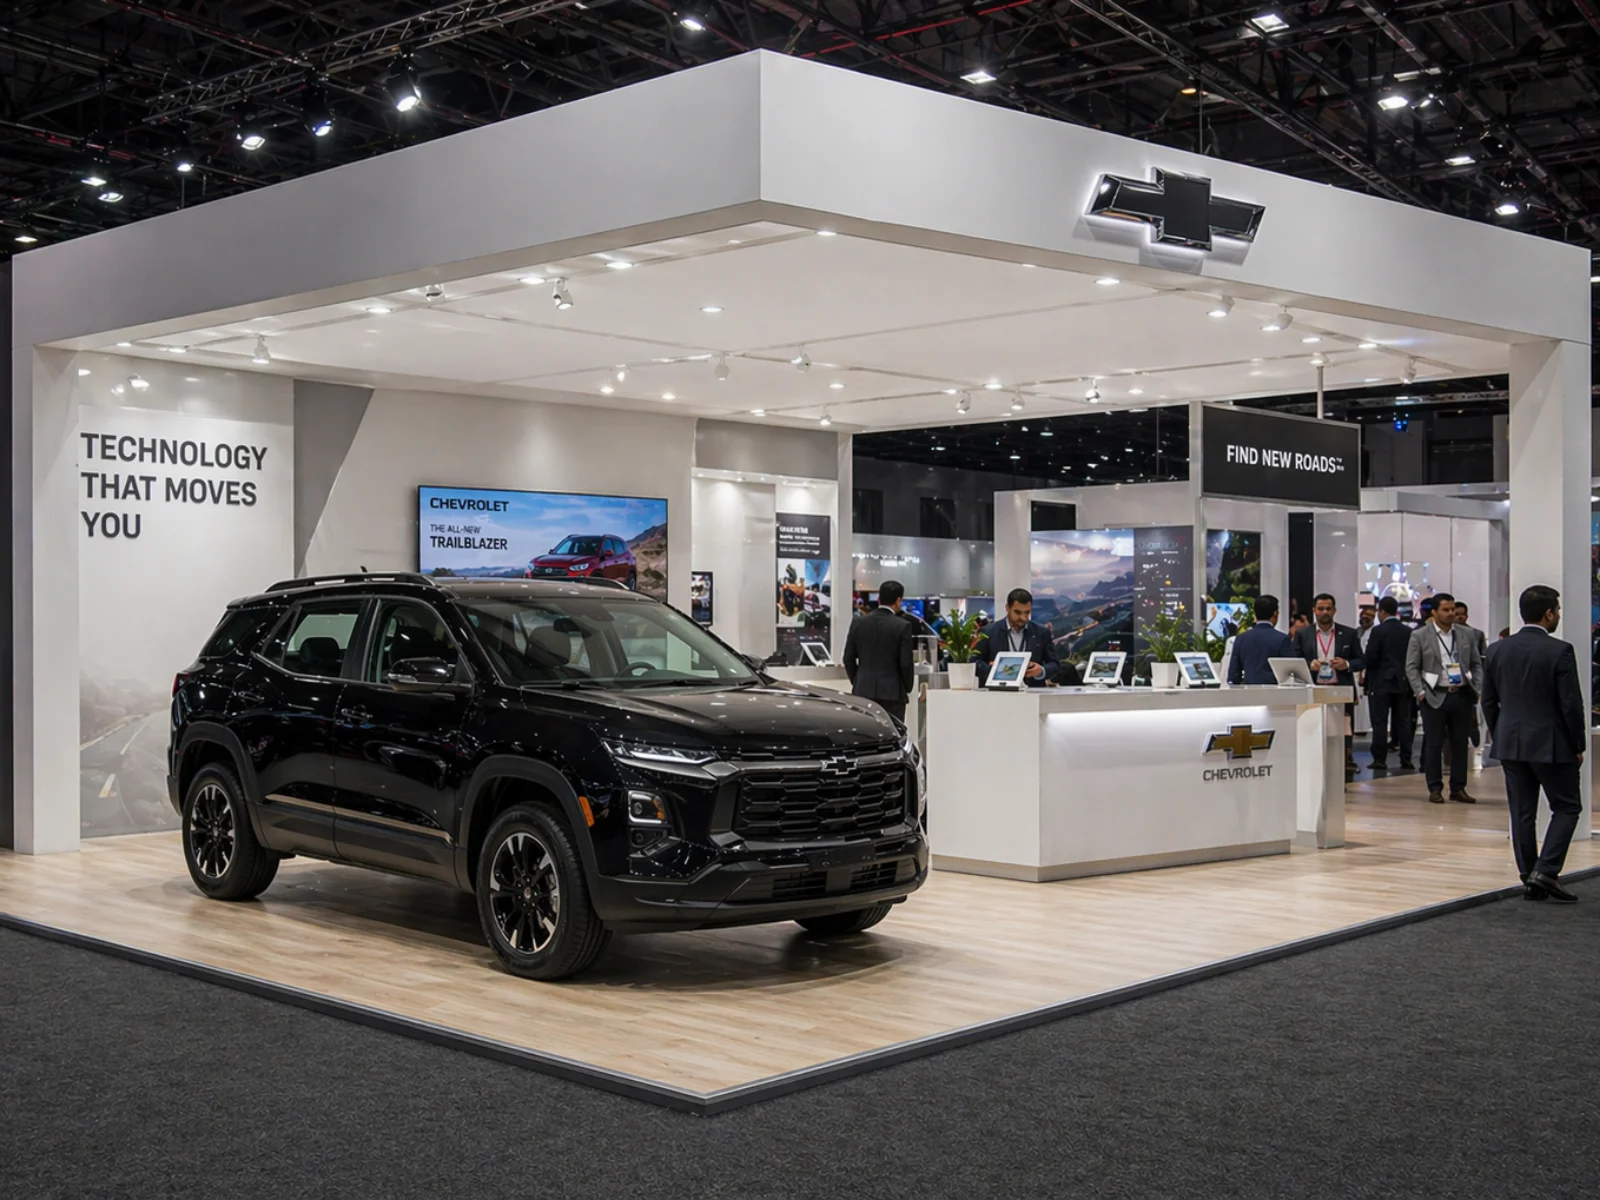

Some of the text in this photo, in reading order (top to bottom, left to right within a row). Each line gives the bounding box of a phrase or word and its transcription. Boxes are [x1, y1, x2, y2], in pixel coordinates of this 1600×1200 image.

[80, 432, 268, 470] TECHNOLOGY
[1226, 444, 1336, 474] FIND NEW ROADS
[80, 472, 257, 507] THAT MOVES
[430, 497, 509, 512] CHEVROLET
[80, 511, 141, 539] YOU
[430, 523, 482, 534] THE ALL-NEW
[430, 535, 508, 550] TRAILBLAZER
[1202, 764, 1273, 782] CHEVROLET
